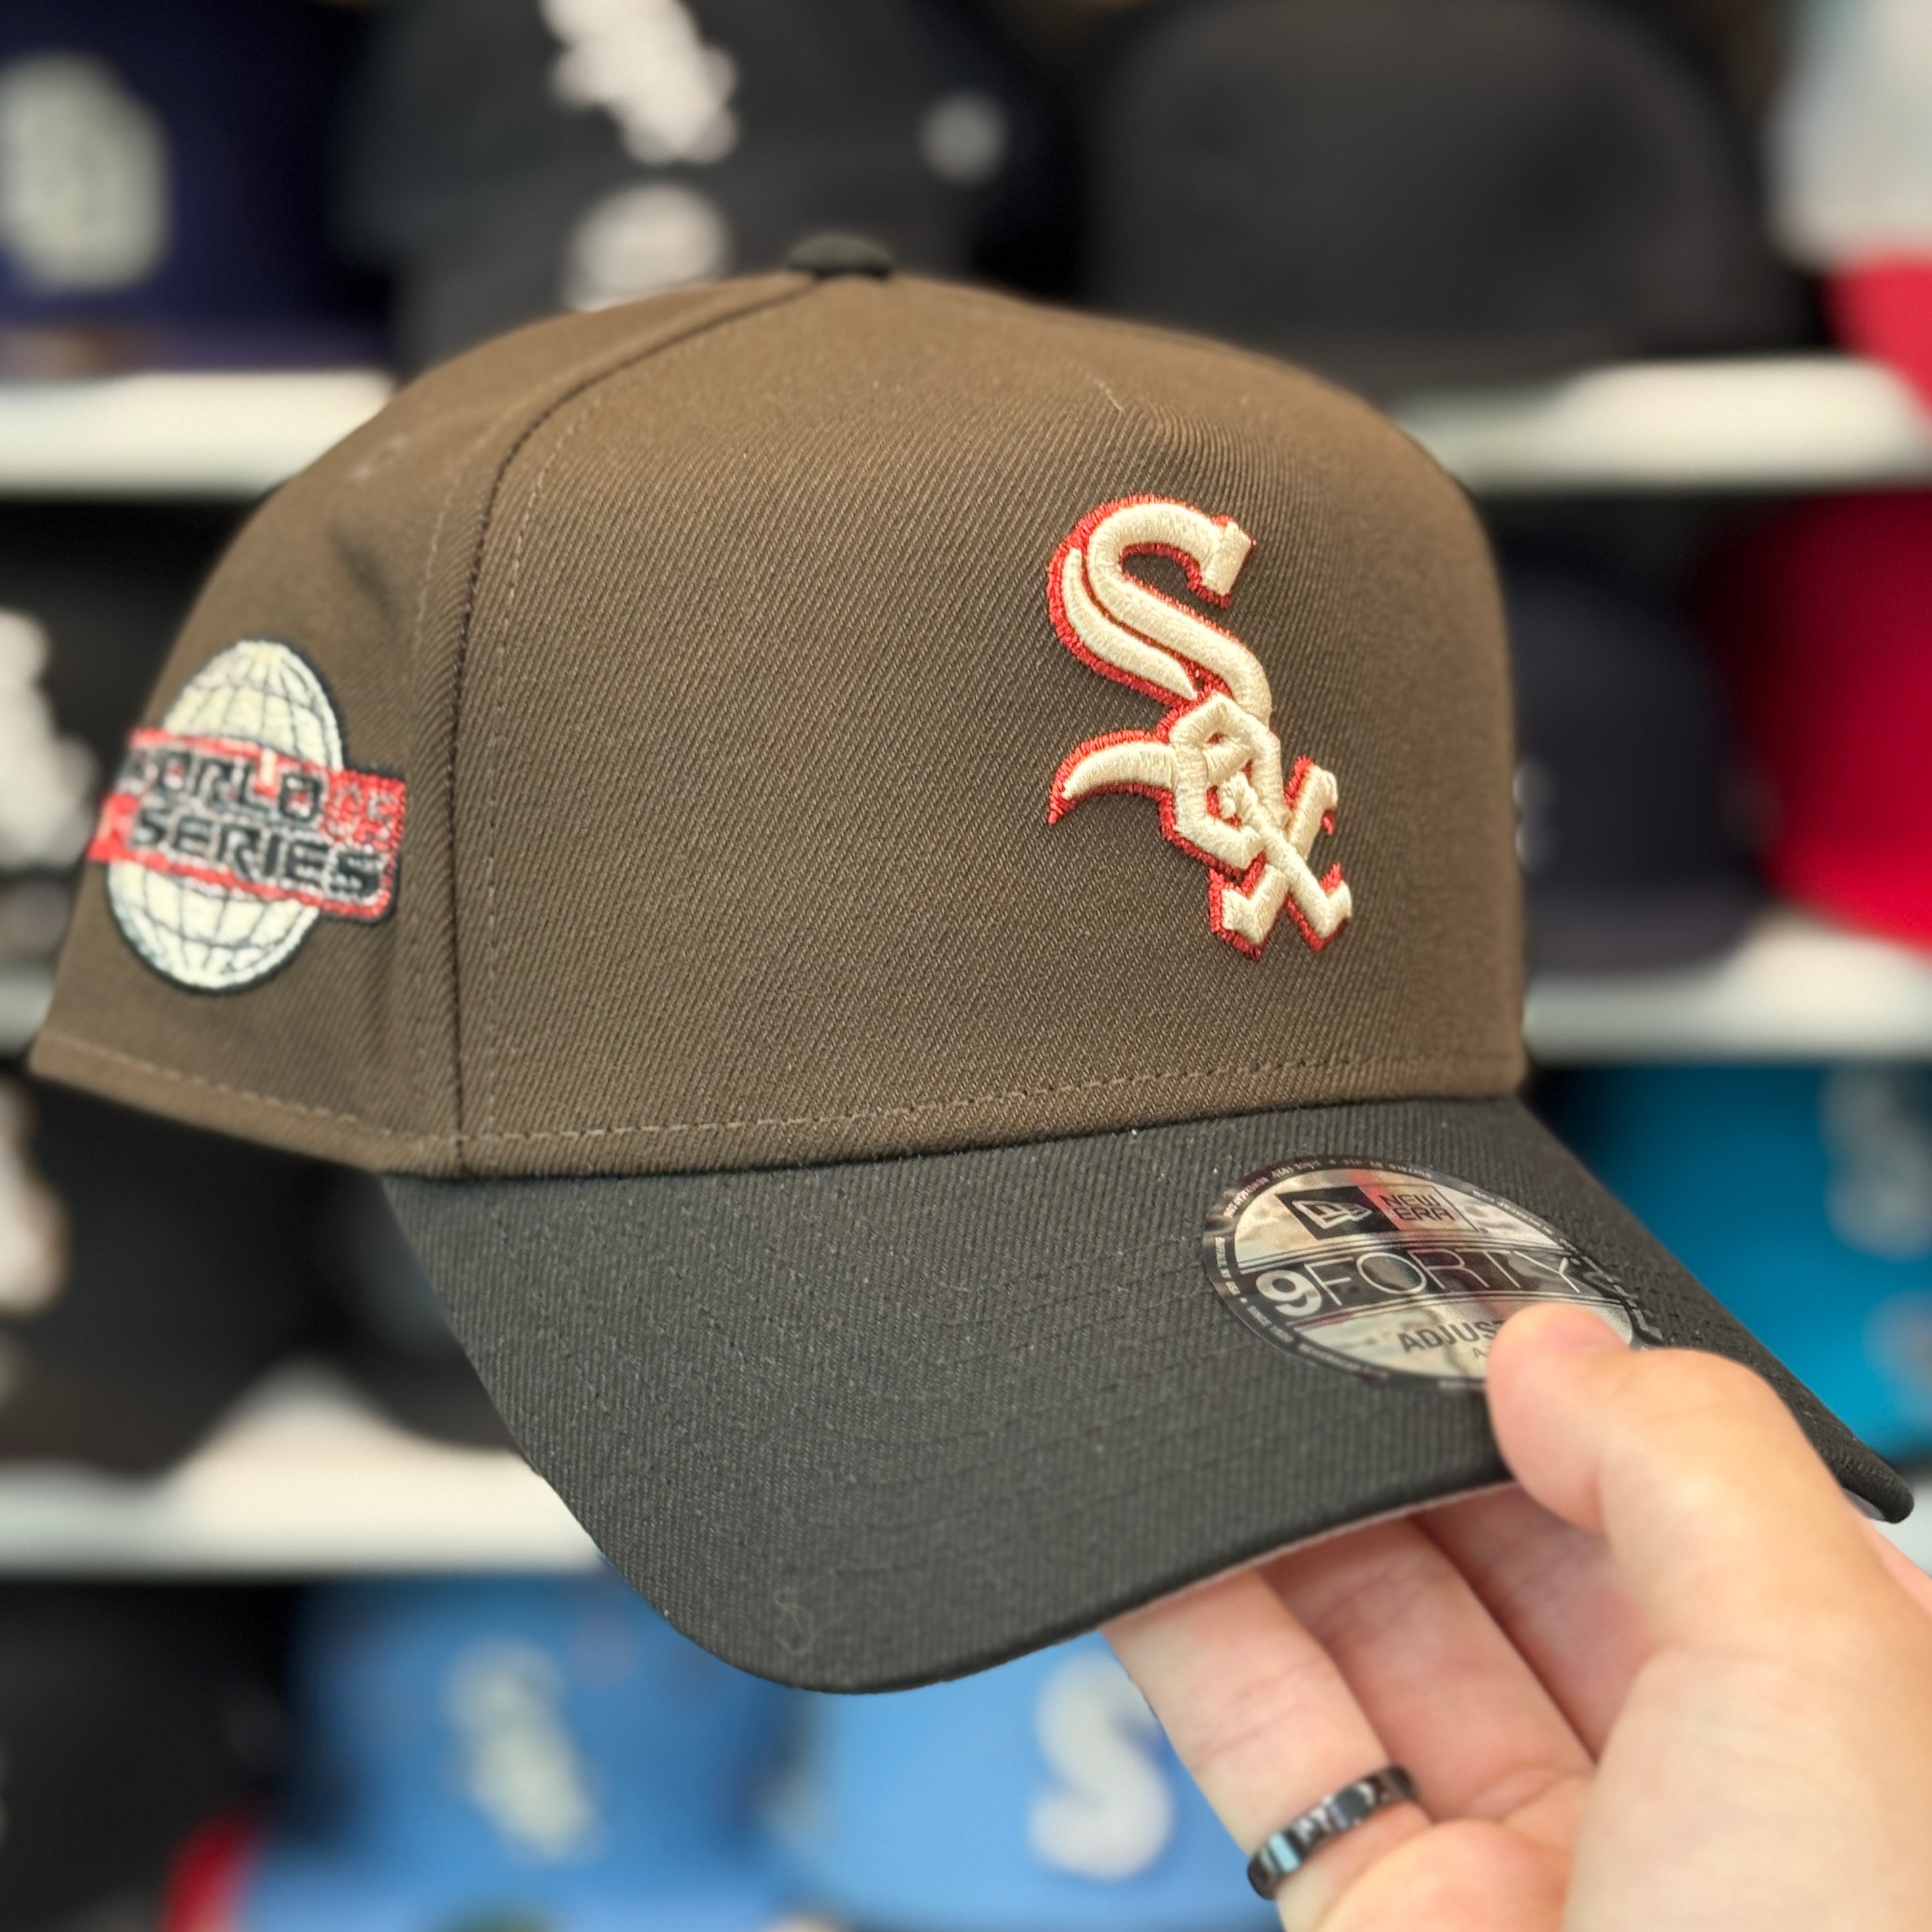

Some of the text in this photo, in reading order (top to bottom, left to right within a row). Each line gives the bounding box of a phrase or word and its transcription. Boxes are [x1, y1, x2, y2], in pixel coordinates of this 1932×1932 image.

[133, 809, 385, 895] SERIES
[1378, 1194, 1441, 1208] NEW
[1392, 1207, 1456, 1221] ERA
[1256, 1250, 1581, 1317] 9FORTY
[1397, 1321, 1505, 1353] ADJUS
